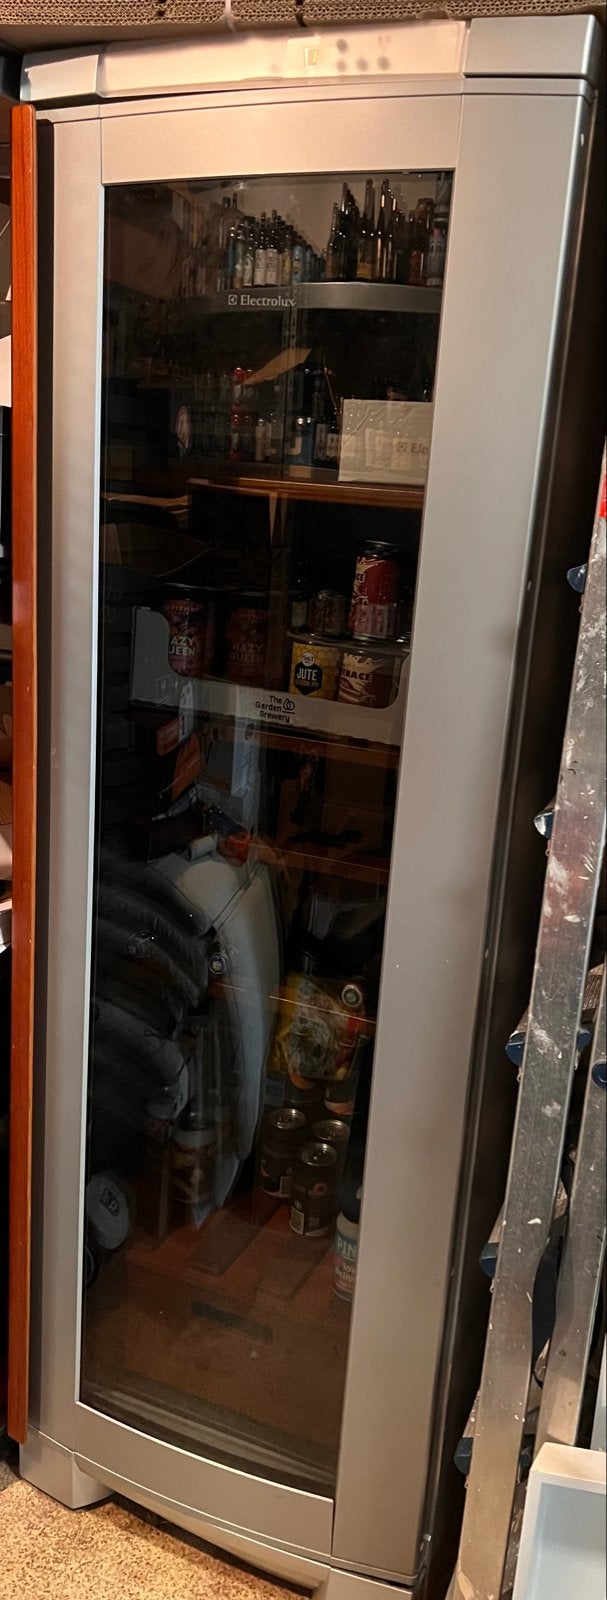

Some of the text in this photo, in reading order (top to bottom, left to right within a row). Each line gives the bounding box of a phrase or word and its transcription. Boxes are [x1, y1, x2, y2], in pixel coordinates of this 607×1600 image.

[240, 295, 295, 307] Electrolux
[411, 442, 429, 454] Ele
[170, 635, 194, 646] AZY
[168, 646, 195, 657] UEEN
[232, 642, 263, 653] HAZY
[296, 667, 318, 681] JUTE
[342, 669, 374, 681] ENACE
[269, 695, 283, 704] The
[255, 701, 282, 712] Garden
[260, 710, 290, 723] Brewery
[336, 1235, 356, 1258] PIN
